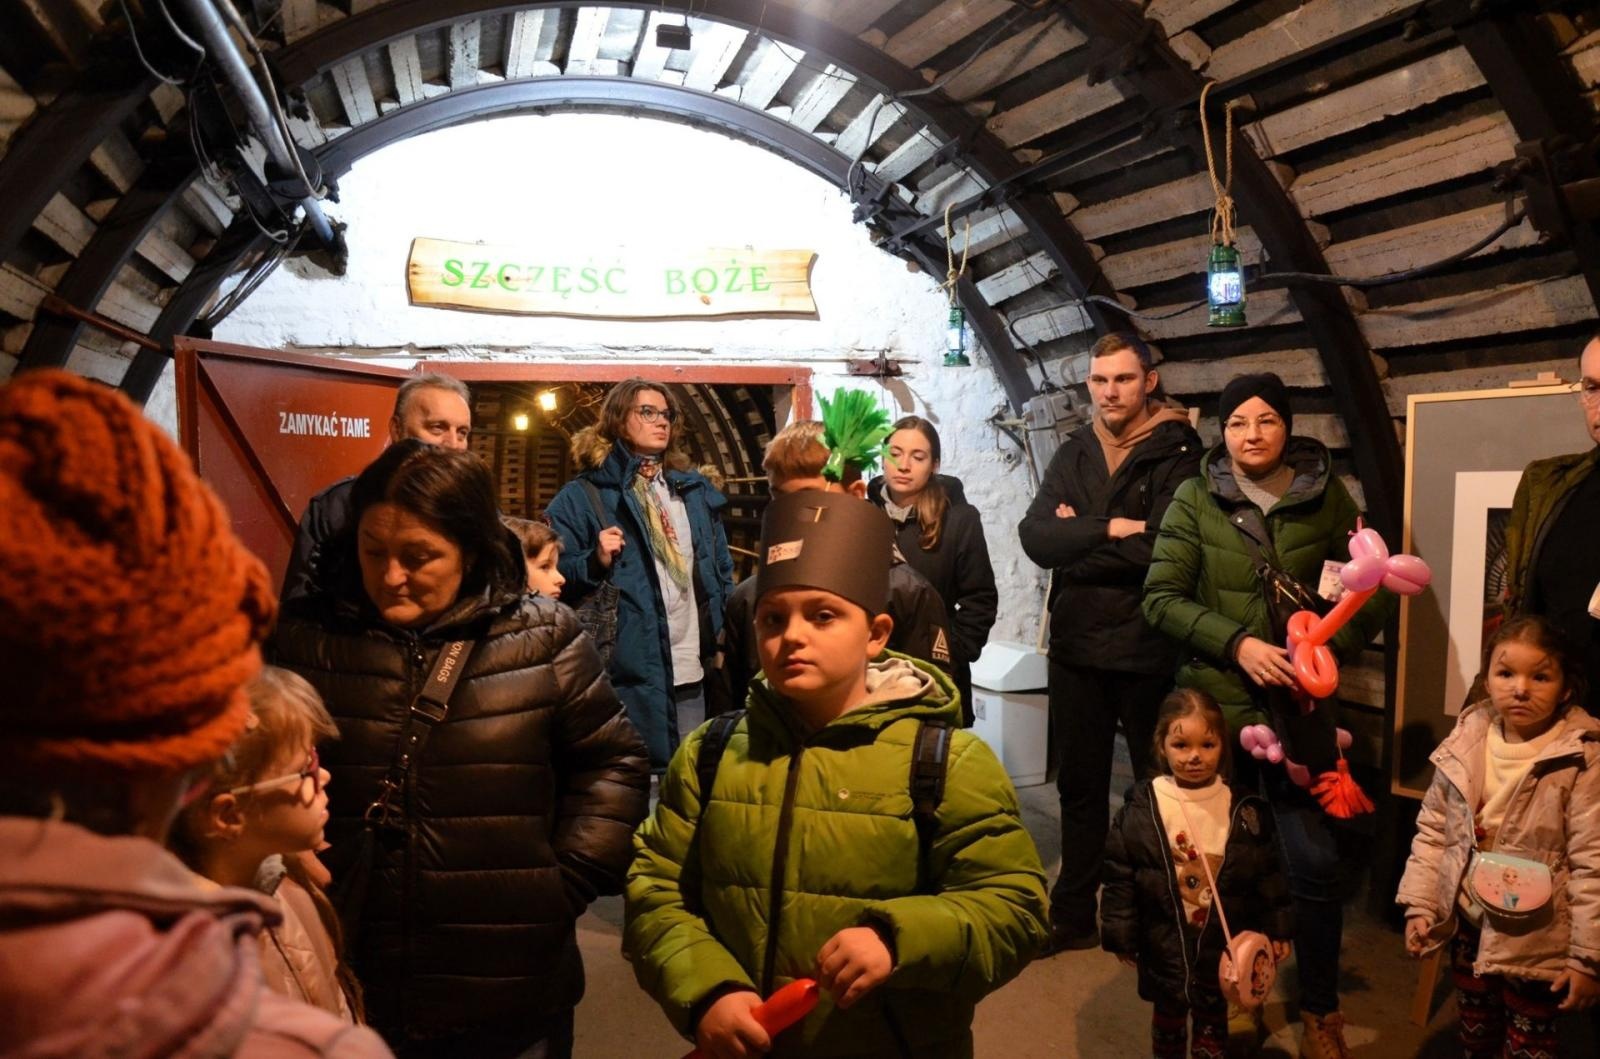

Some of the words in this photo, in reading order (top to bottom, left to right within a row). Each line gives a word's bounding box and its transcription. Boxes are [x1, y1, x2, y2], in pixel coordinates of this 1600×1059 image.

[664, 258, 772, 295] BOŻE
[279, 411, 338, 437] ZAMYKAĆ
[437, 657, 456, 683] BAGS
